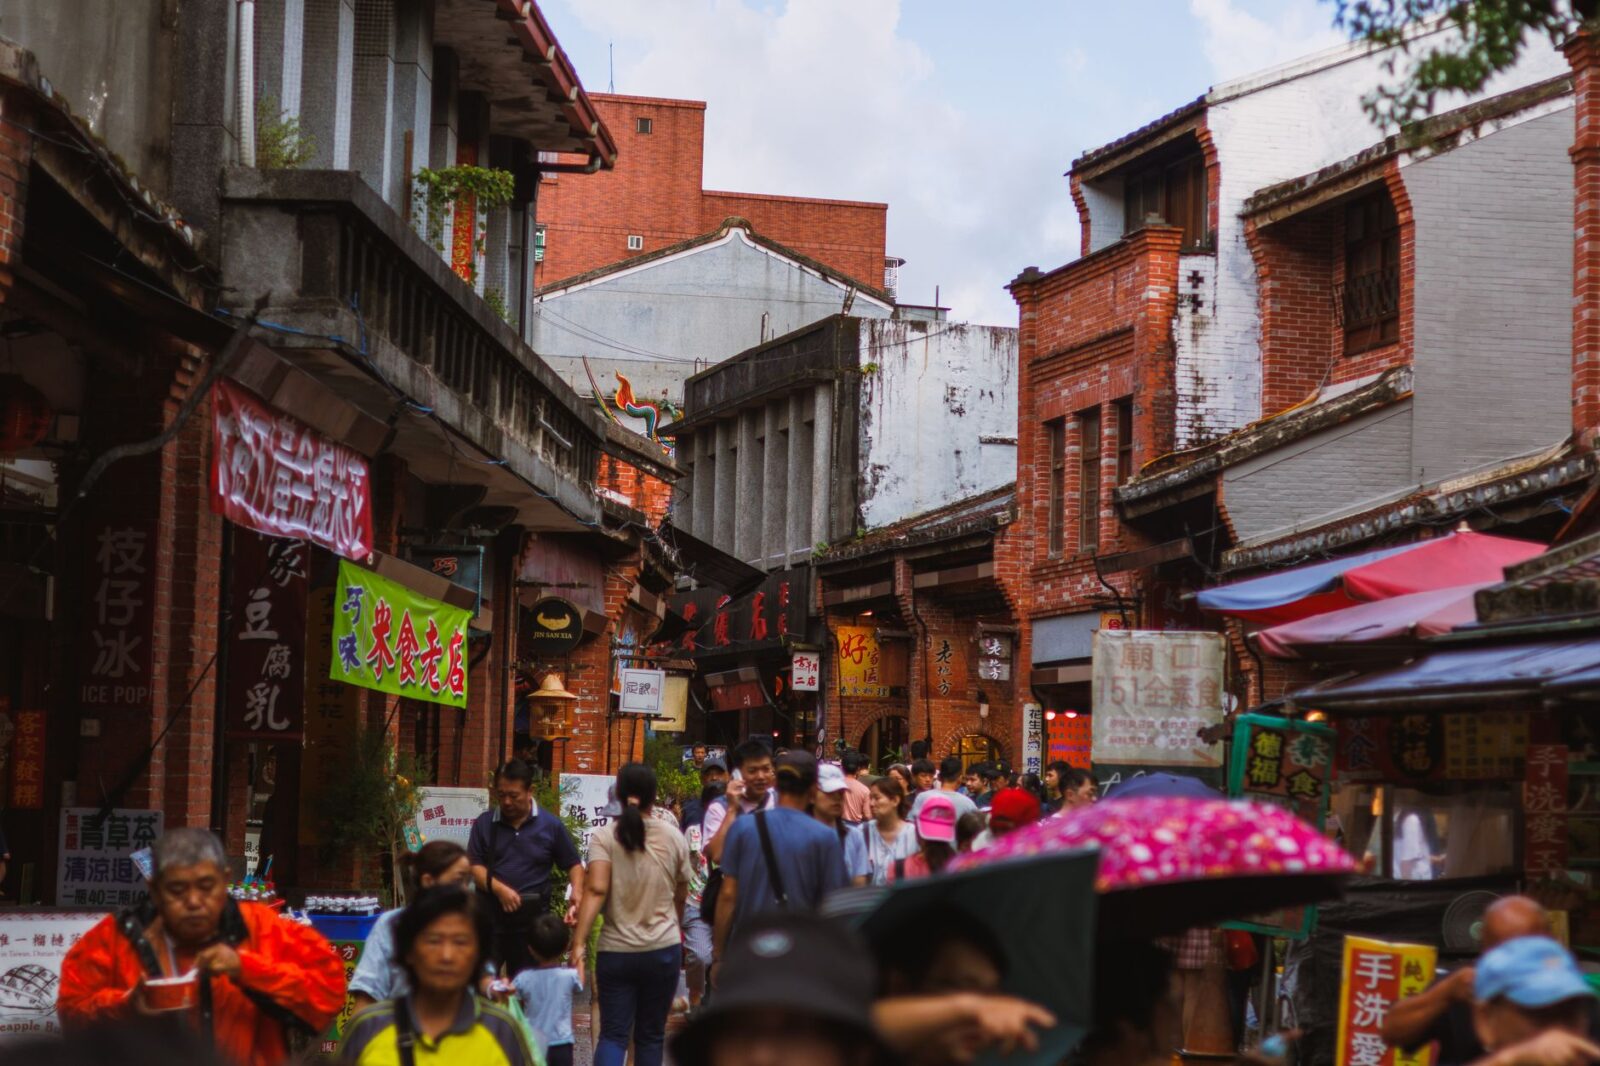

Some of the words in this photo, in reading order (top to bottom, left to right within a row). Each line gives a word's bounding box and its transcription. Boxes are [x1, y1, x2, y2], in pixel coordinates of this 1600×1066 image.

[92, 526, 147, 678] 枝仔冰
[366, 597, 465, 696] 米食老店
[936, 640, 952, 695] 老地方
[987, 638, 1001, 680] 老地方
[1120, 643, 1200, 670] 廟口
[82, 686, 110, 702] ICE
[795, 676, 816, 686] 二店
[1096, 676, 1219, 709] 151全素食
[1249, 731, 1283, 785] 德福
[1286, 733, 1331, 797] 素食
[81, 815, 157, 851] 青草茶
